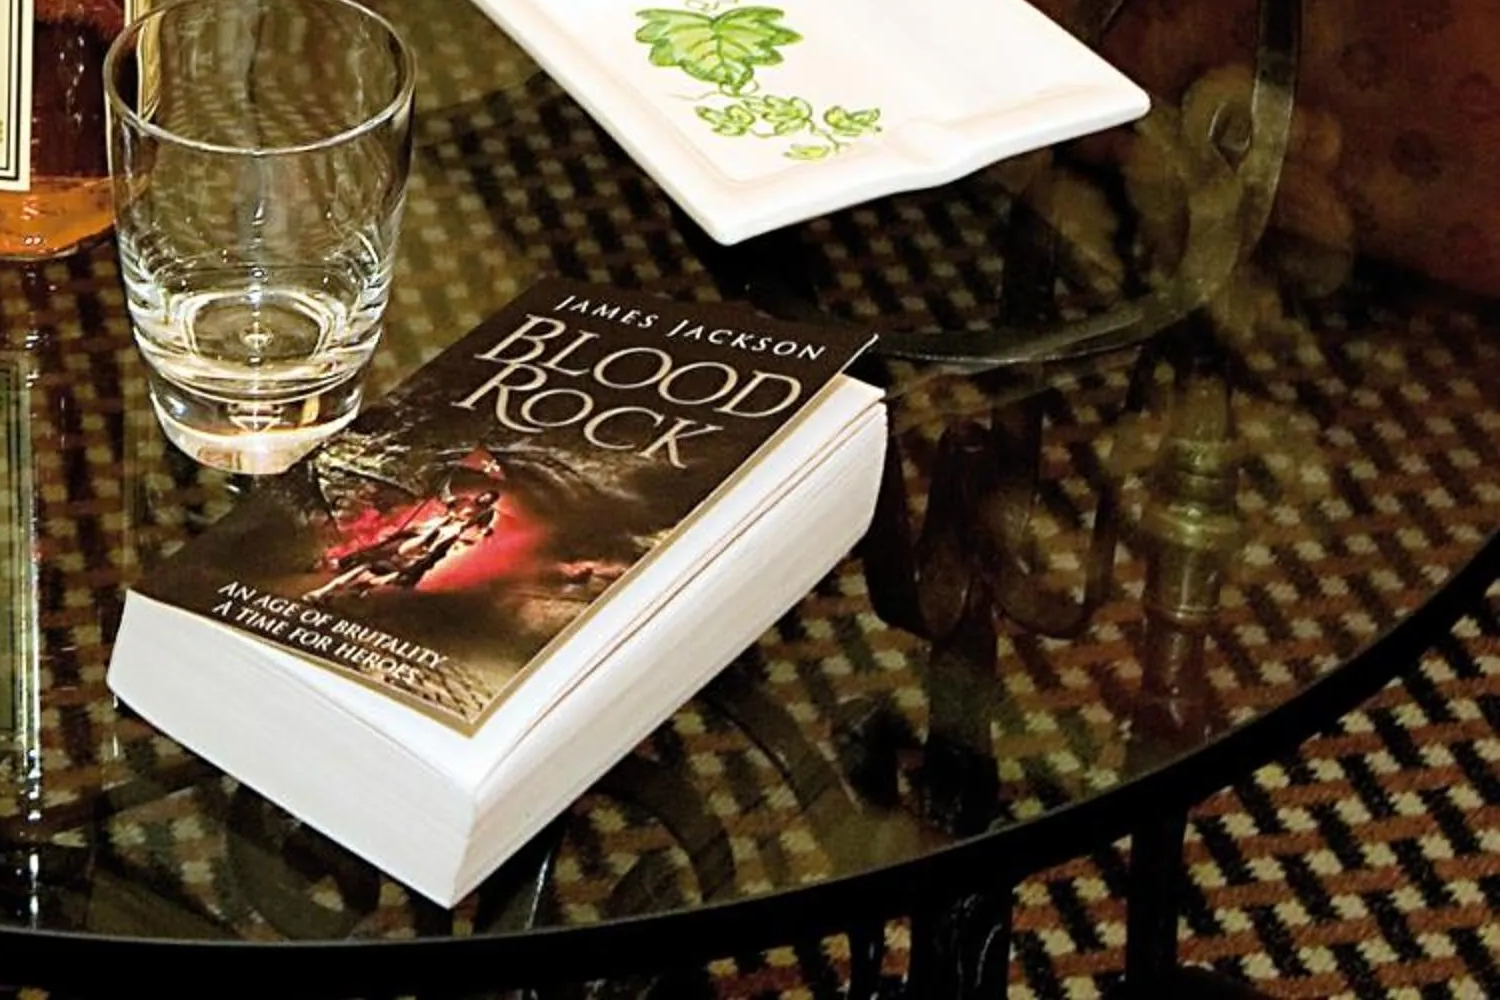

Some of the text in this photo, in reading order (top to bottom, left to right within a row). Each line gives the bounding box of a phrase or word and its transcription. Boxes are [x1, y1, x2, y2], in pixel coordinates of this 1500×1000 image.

[474, 313, 802, 418] BLOOD
[553, 295, 826, 361] JAMES JACKSON
[450, 361, 724, 469] ROCK
[211, 600, 421, 685] A TIME FOR HEROES
[217, 580, 449, 669] AN AGE OF BRUTALITY
